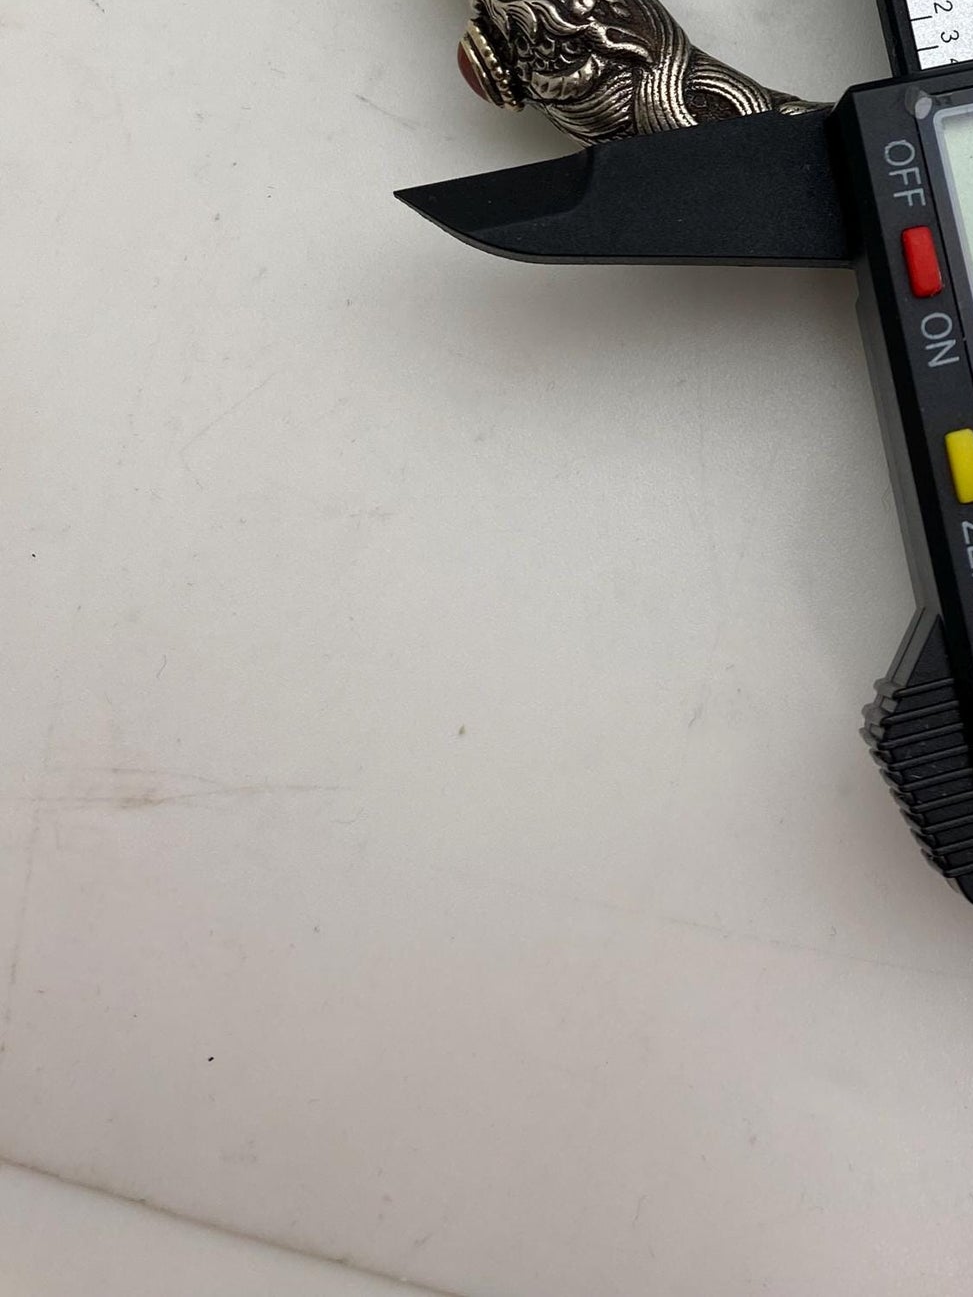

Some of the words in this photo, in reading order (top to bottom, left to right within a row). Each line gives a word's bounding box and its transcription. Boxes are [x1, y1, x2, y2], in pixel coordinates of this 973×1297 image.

[934, 0, 953, 13] 2
[941, 30, 959, 43] 3
[885, 139, 926, 206] OFF
[921, 312, 959, 367] ON
